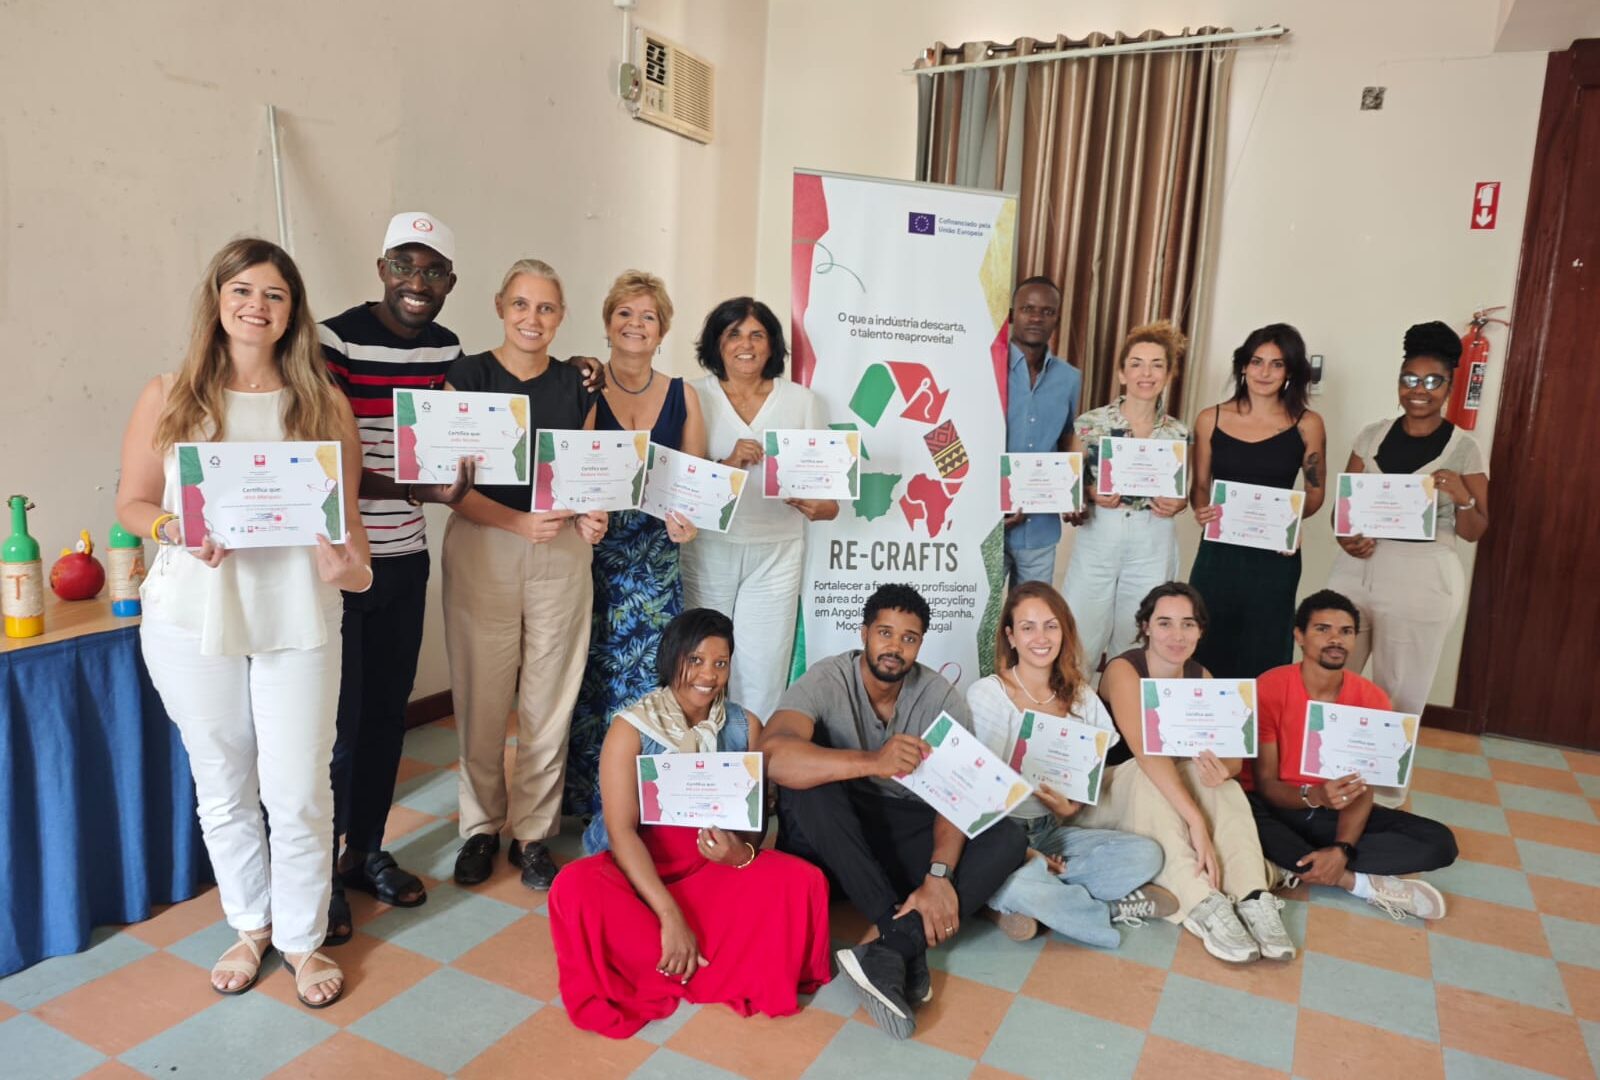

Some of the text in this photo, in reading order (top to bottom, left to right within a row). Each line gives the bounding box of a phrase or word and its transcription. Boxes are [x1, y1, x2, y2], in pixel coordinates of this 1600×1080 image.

[938, 217, 991, 230] Cofinanciado pela
[938, 226, 983, 237] União Europeia
[838, 312, 966, 334] O que a indústria descarta,
[850, 328, 954, 345] o talento reaproveita!
[829, 539, 958, 572] RE-CRAFTS
[7, 573, 31, 600] T
[814, 580, 863, 591] Fortalecer
[864, 583, 871, 591] a
[922, 582, 977, 593] profissional
[814, 592, 976, 608] na área do upcycling
[814, 608, 830, 617] em
[931, 608, 974, 620] Espanha,
